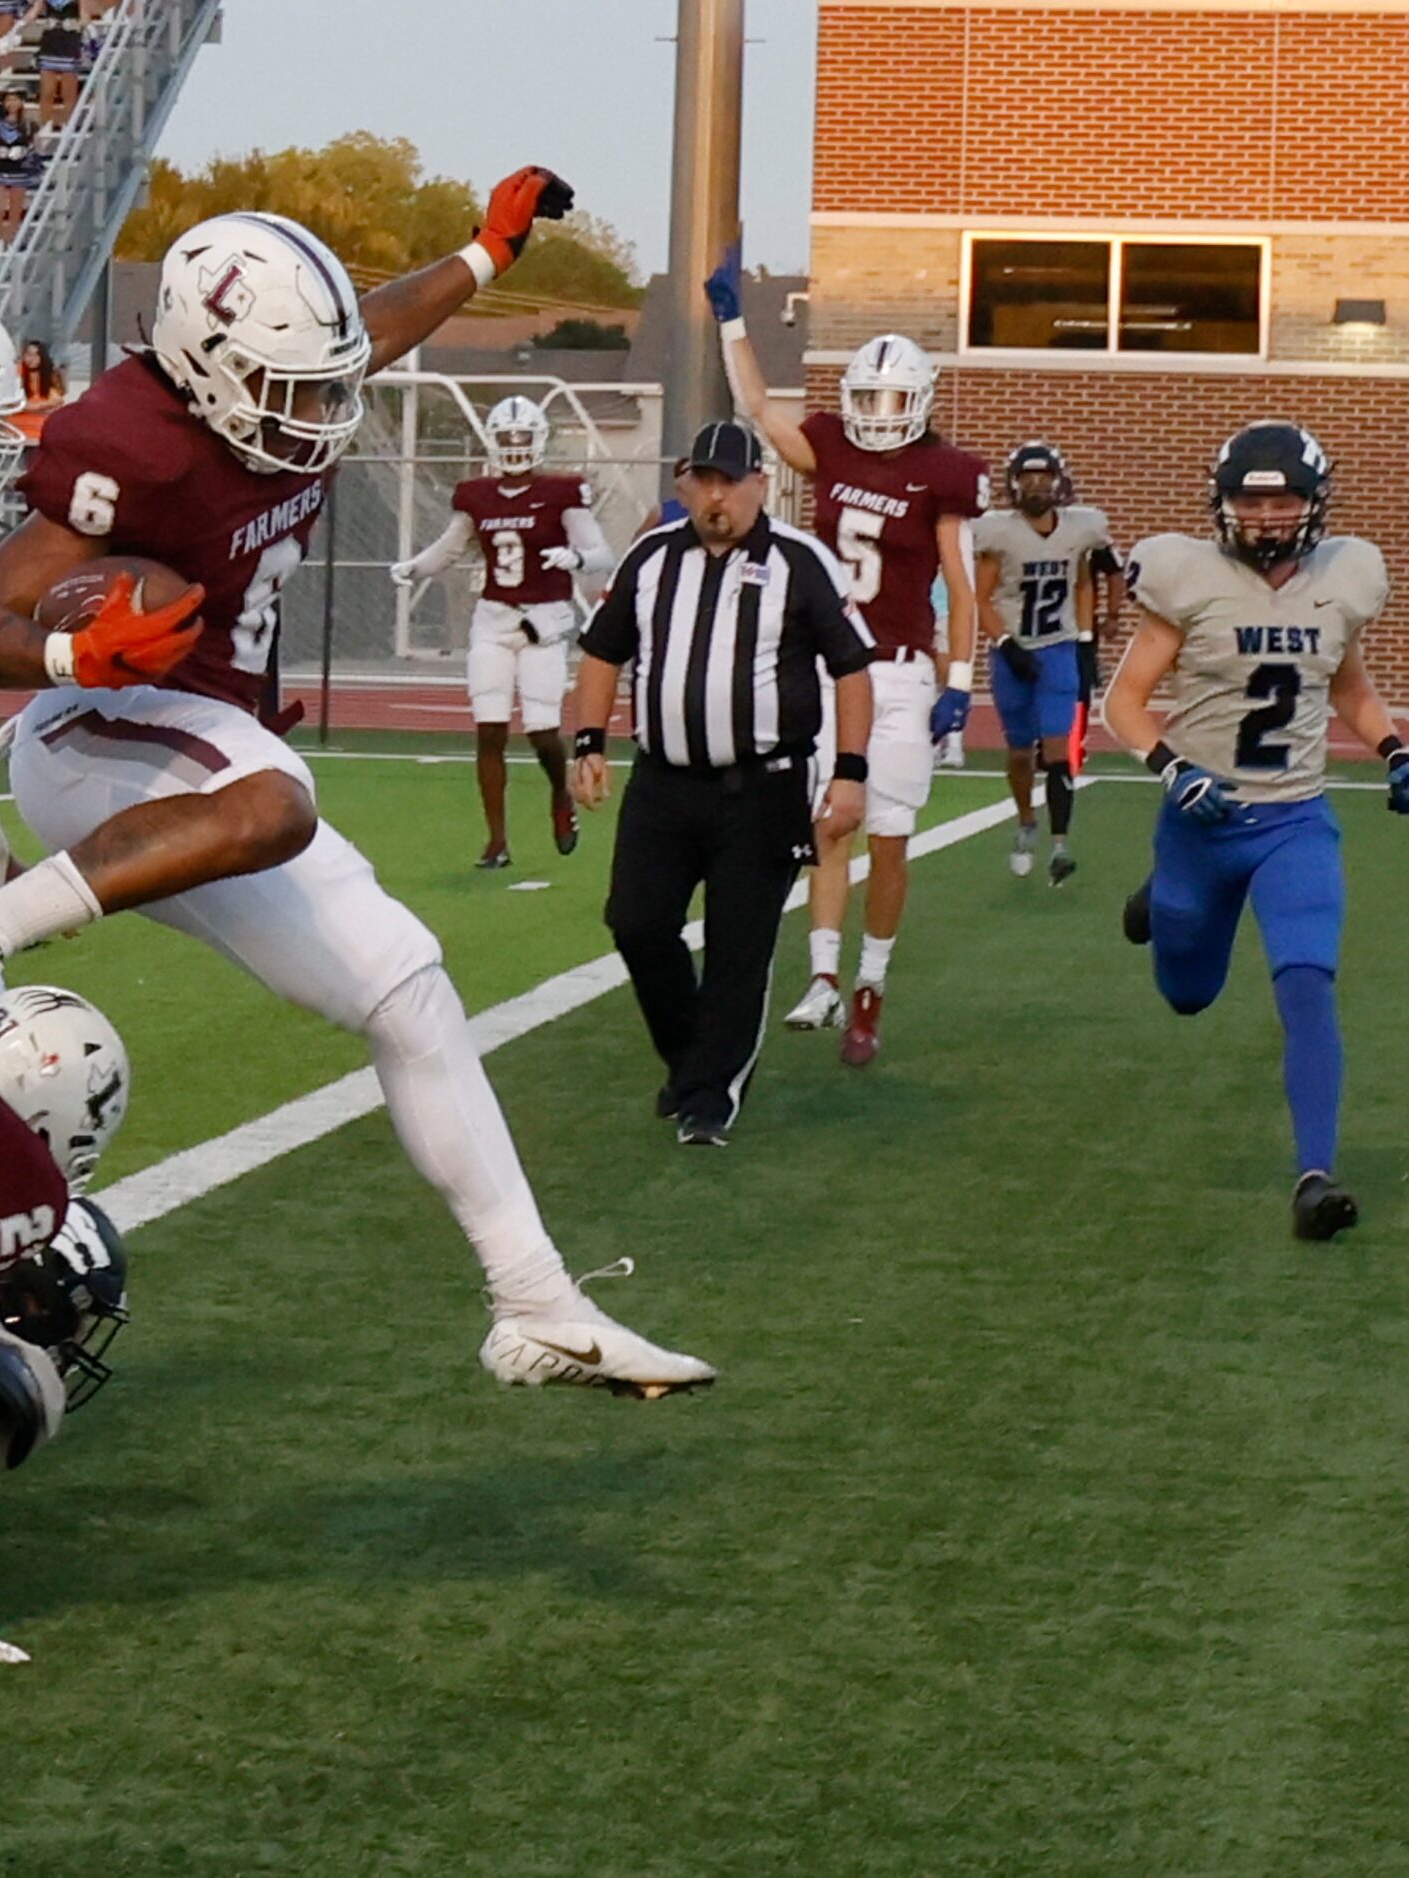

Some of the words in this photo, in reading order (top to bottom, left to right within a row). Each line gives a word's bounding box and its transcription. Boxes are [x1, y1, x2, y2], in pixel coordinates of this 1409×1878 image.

[68, 471, 120, 536] 6
[229, 478, 323, 560] FARMERS
[829, 482, 909, 518] FARMERS
[837, 506, 886, 605] 5
[1019, 578, 1068, 637] 12
[1234, 626, 1320, 655] WEST
[1234, 662, 1302, 769] 2
